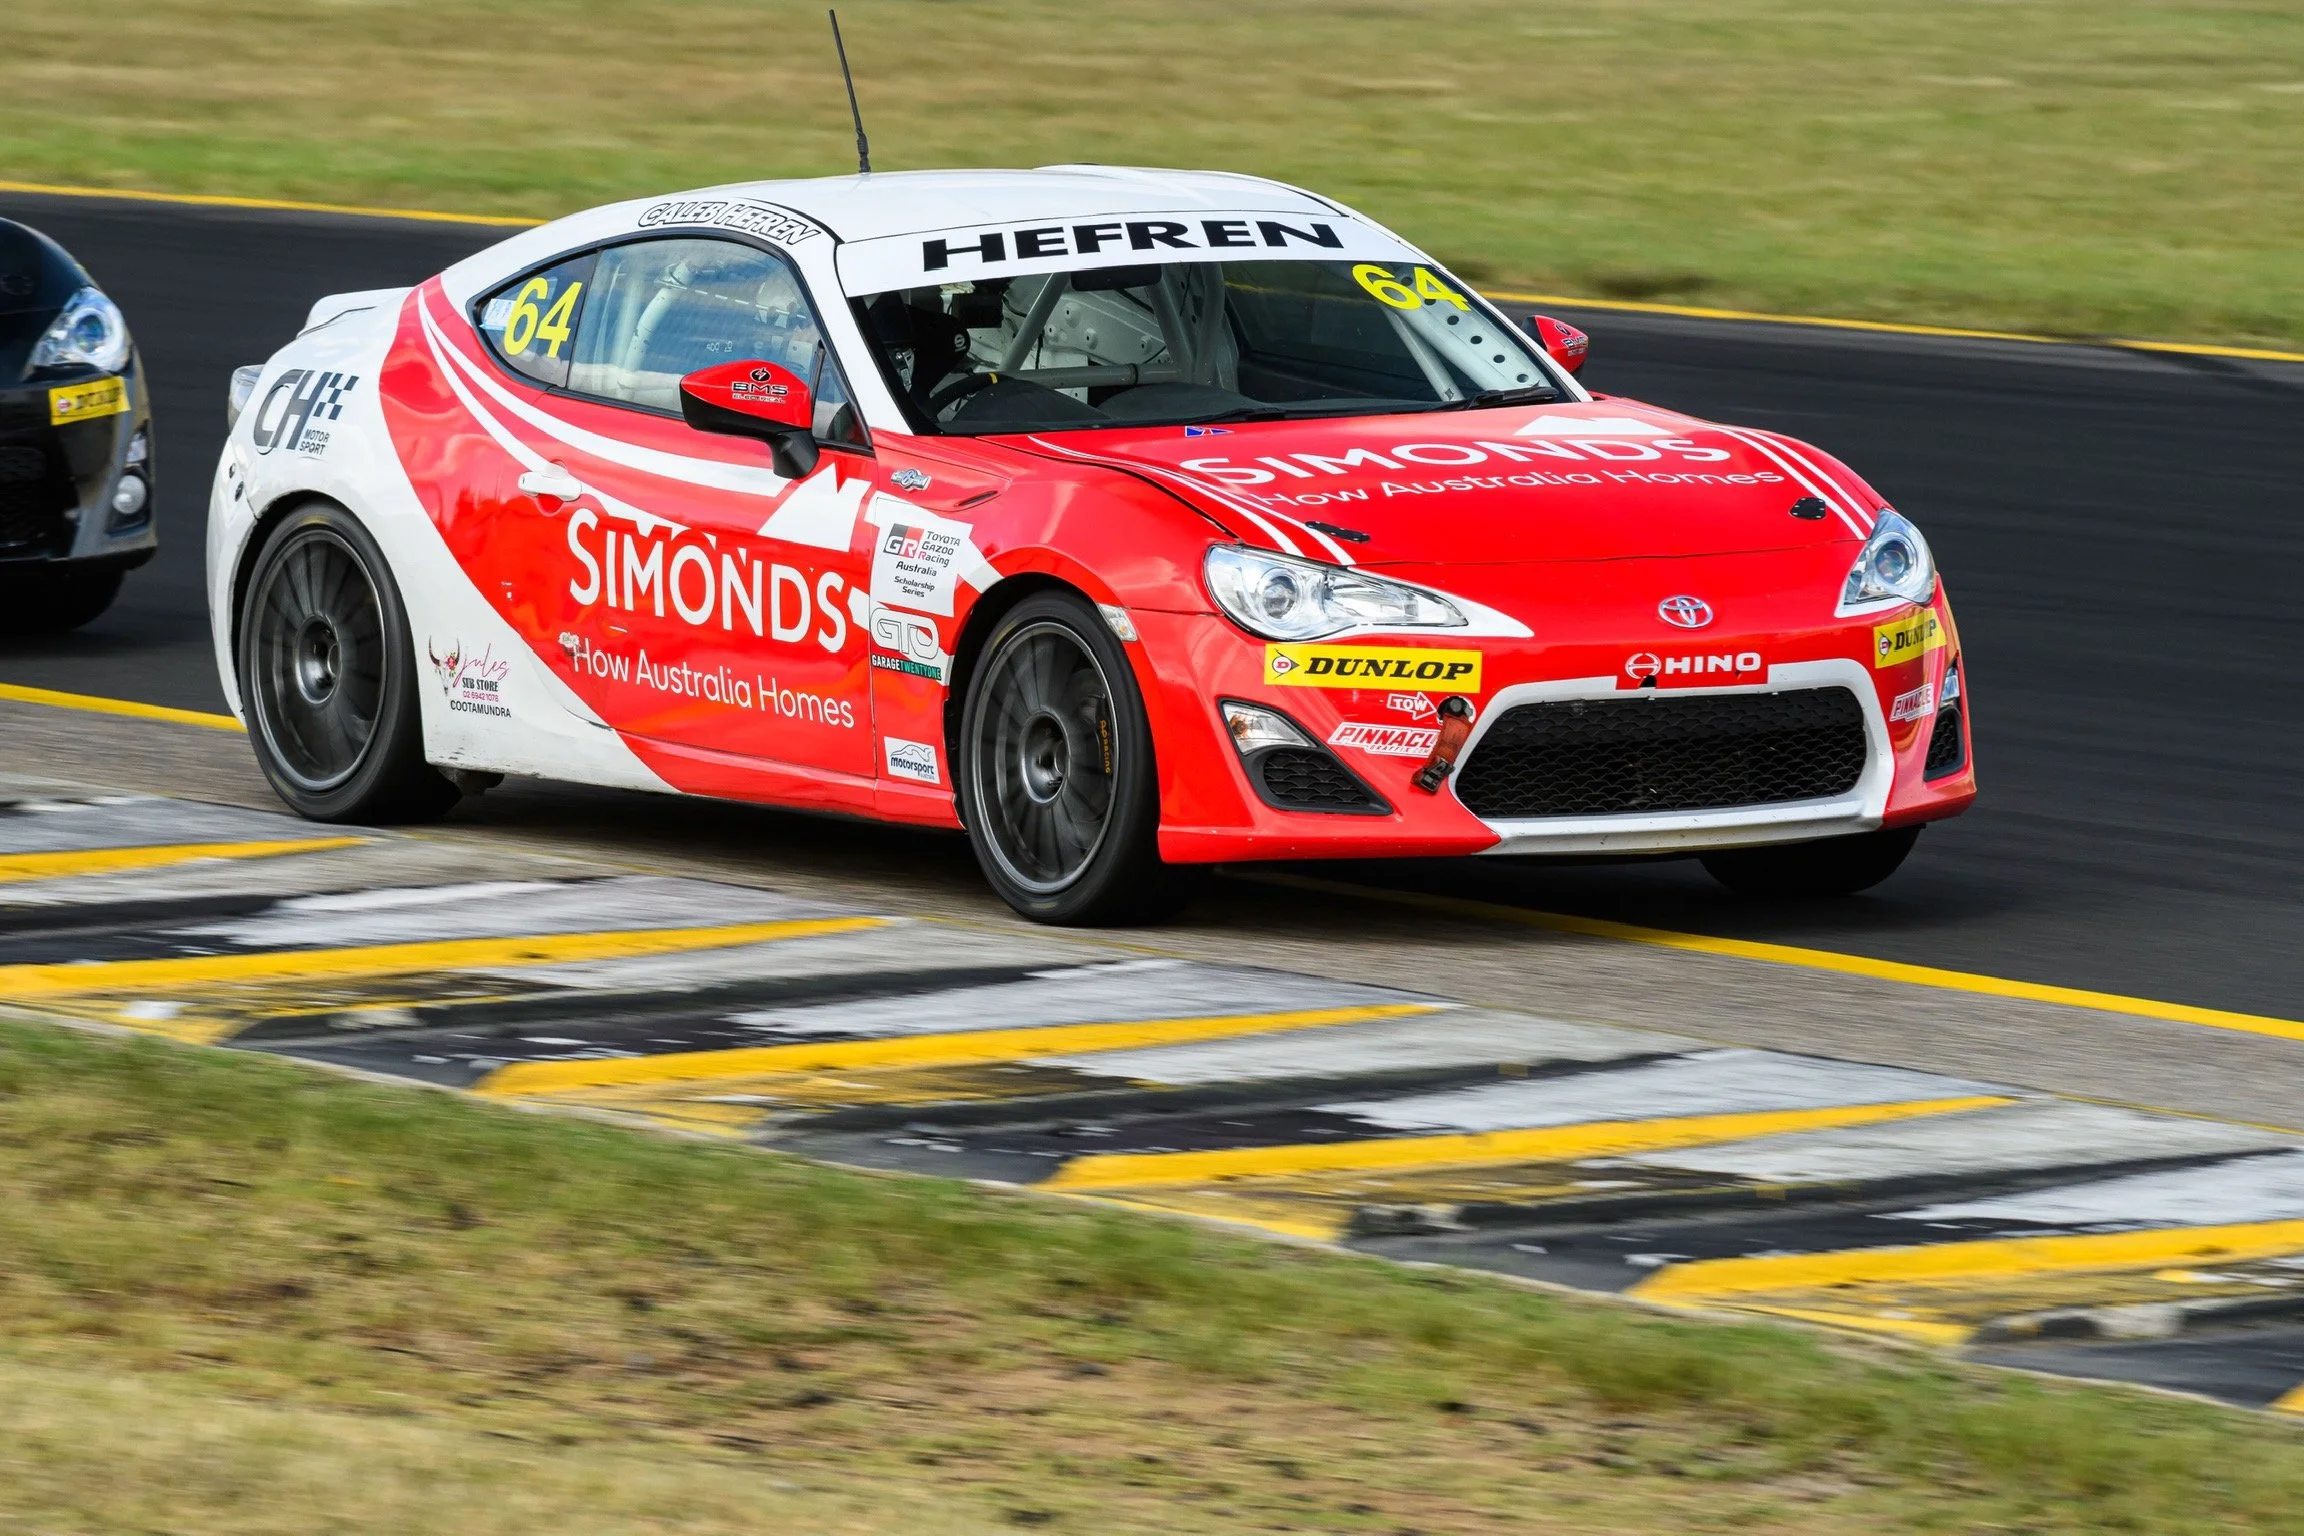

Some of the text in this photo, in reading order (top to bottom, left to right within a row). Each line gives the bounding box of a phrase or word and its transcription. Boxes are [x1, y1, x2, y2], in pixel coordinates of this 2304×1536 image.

[638, 202, 821, 245] CALEB HEFREN
[923, 220, 1344, 272] HEFREN
[1352, 264, 1472, 311] 64
[503, 277, 583, 358] 64
[732, 382, 788, 396] BMS
[304, 429, 330, 443] MOTOR
[299, 441, 326, 455] SPORT
[1180, 440, 1731, 484] SIMONDS
[1252, 470, 1784, 506] How Australia Homes
[885, 531, 961, 557] GR TOYOTA
[921, 541, 954, 556] GAZOO
[895, 561, 937, 577] Australia
[918, 551, 950, 568] Racing
[567, 508, 847, 653] SIMONDS
[894, 576, 935, 592] Scholarship
[902, 586, 925, 598] Series
[452, 643, 509, 688] jules
[1304, 657, 1474, 680] DUNLOP
[1665, 652, 1761, 675] HINO
[462, 677, 499, 692] SUB STORE
[573, 638, 855, 729] How Australia Homes
[450, 700, 511, 718] COOTAMUNDRA
[1394, 698, 1427, 711] TOW
[1335, 727, 1439, 749] PINNACL
[890, 757, 935, 776] motorsport
